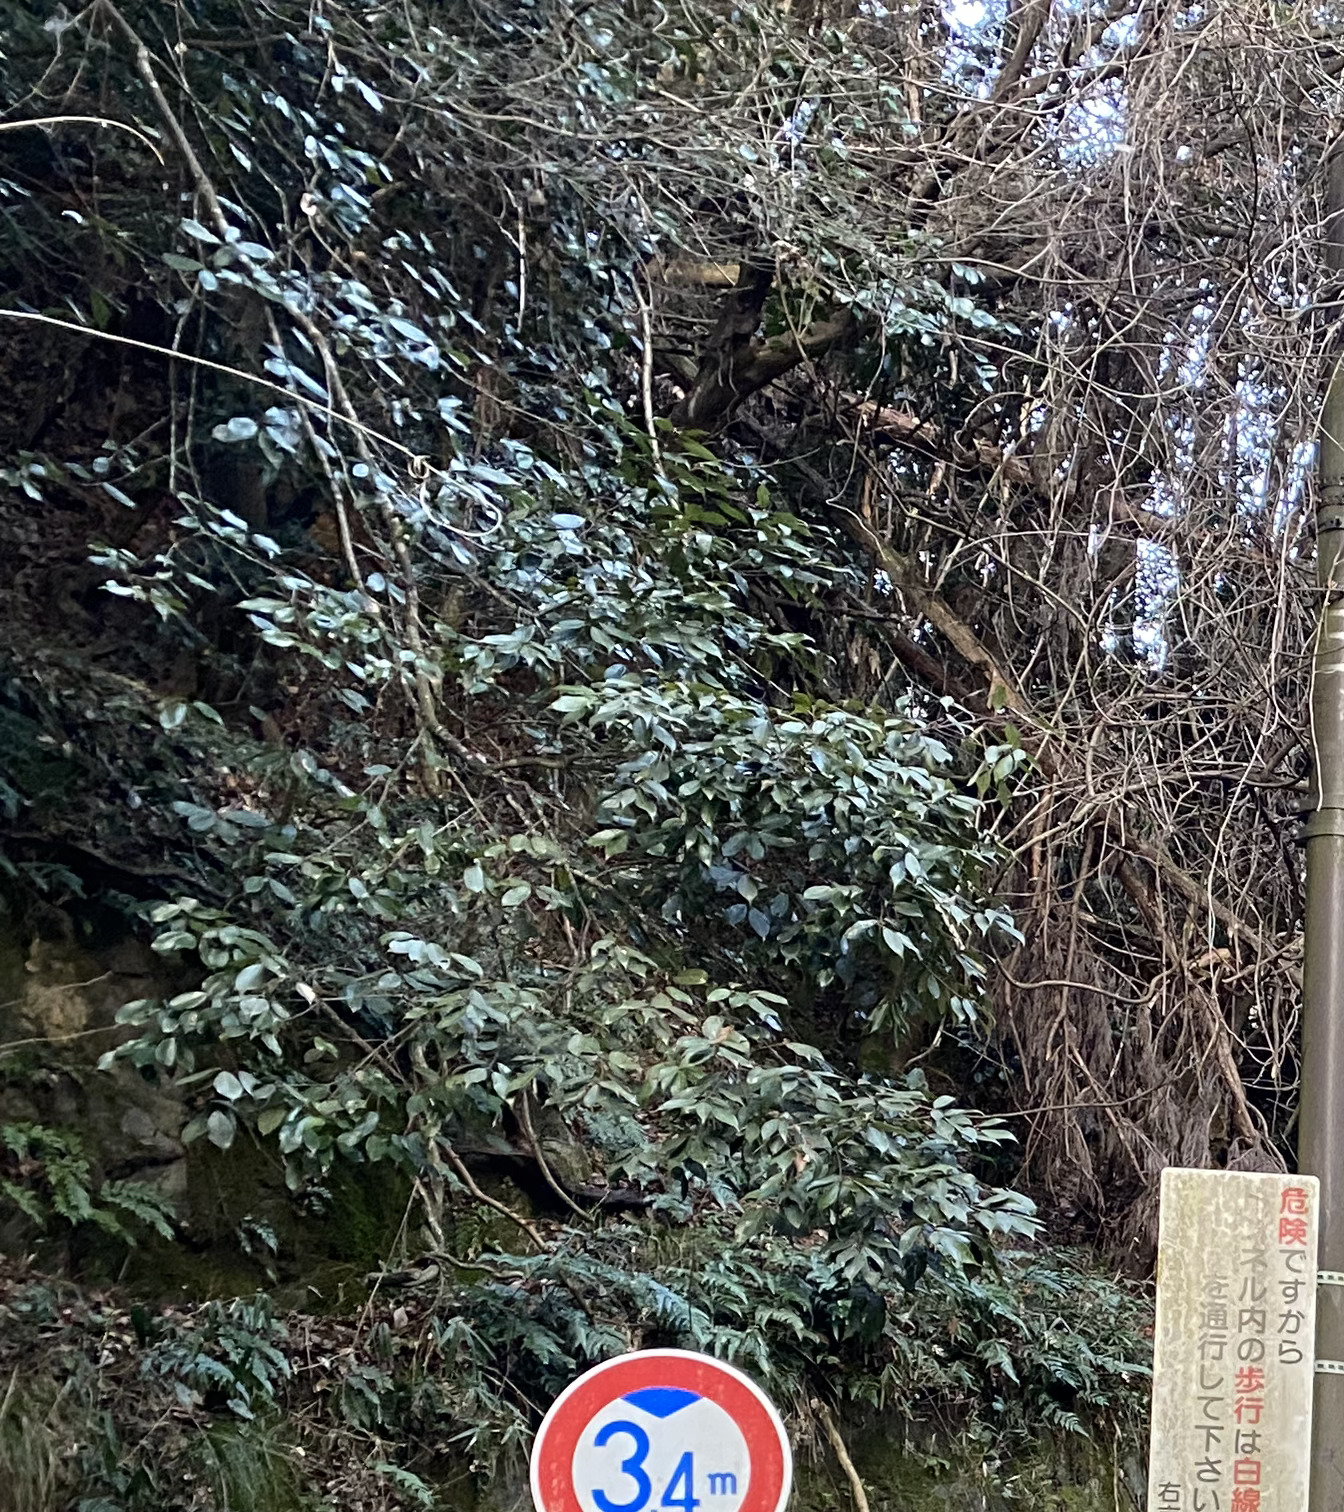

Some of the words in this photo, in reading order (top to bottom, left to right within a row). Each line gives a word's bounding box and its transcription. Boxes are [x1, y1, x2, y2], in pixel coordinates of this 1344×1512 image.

[1276, 1186, 1309, 1365] 危険ですから
[1192, 1271, 1230, 1512] を通行して下さい
